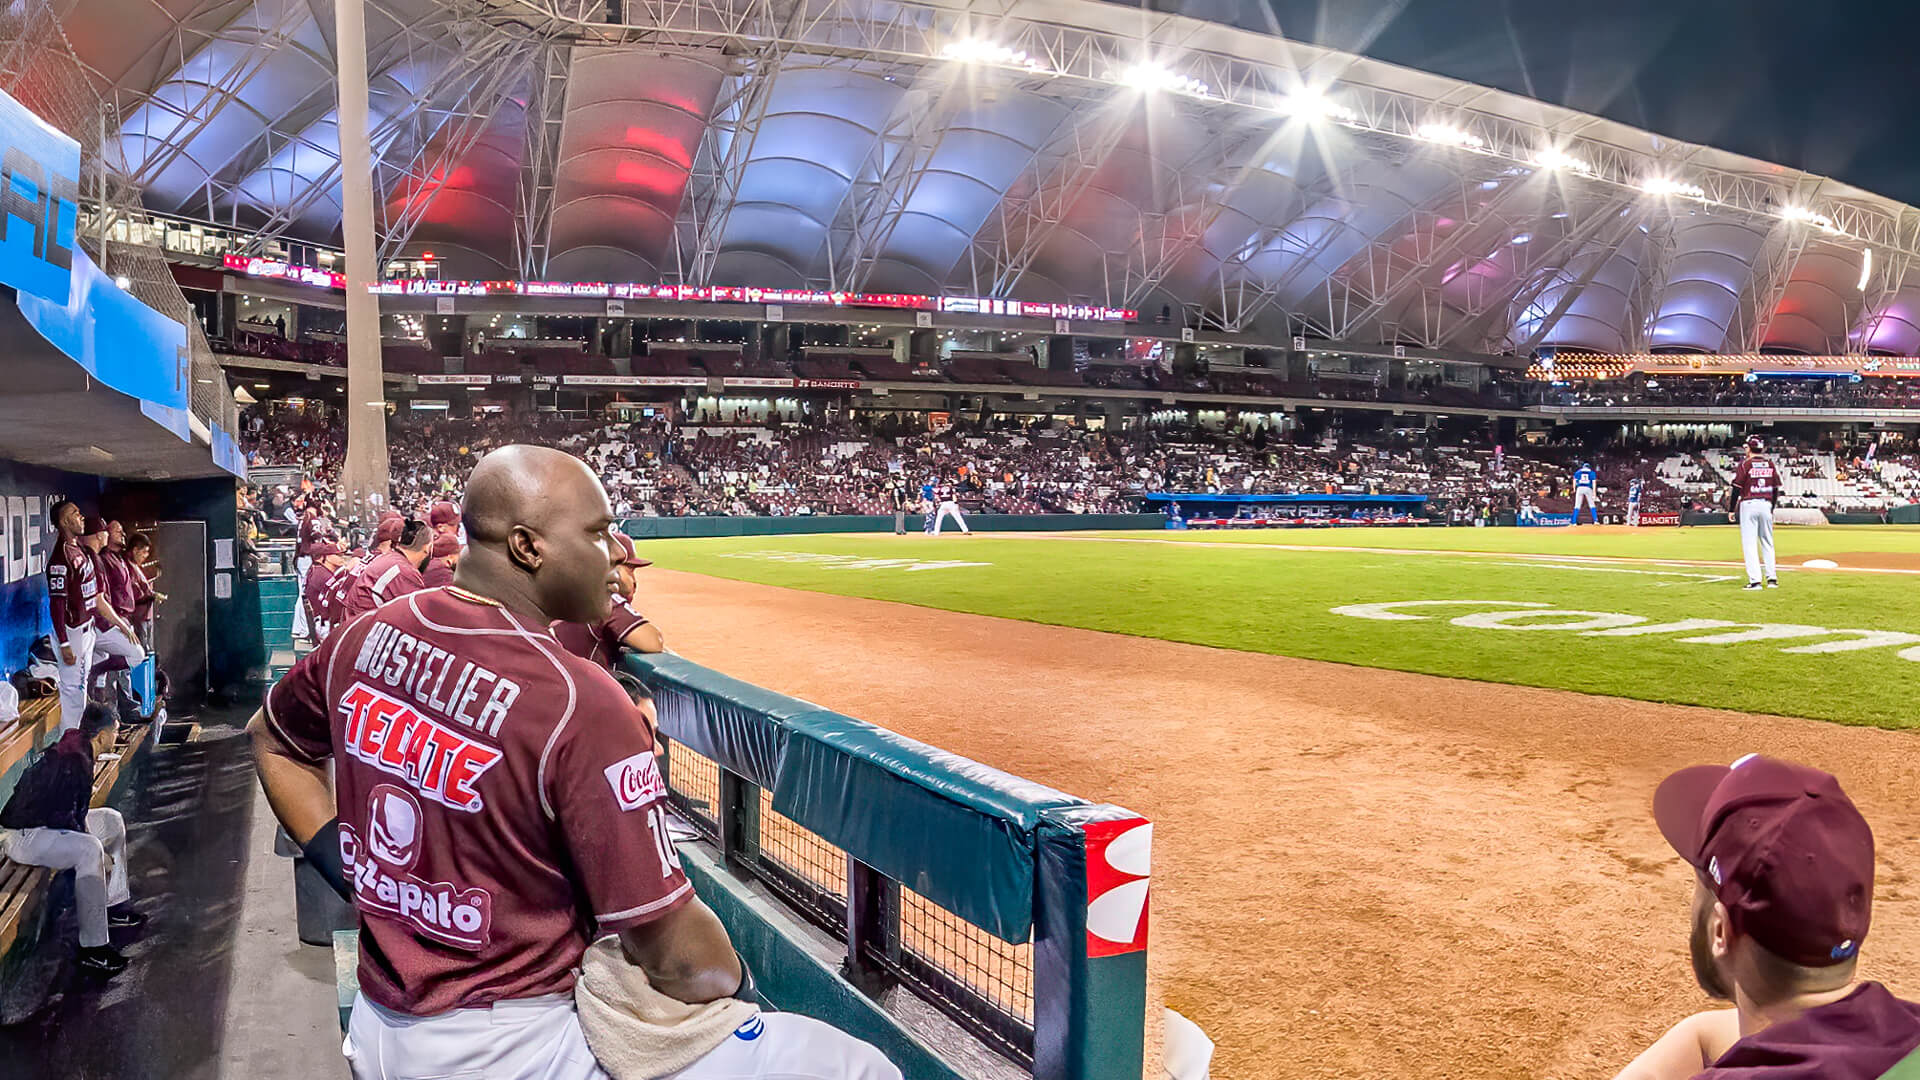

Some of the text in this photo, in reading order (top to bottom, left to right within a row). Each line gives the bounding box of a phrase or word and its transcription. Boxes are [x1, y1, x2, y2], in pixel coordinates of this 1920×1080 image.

[811, 381, 856, 389] BANORTE
[1641, 515, 1680, 525] BANORTE
[50, 577, 65, 590] 58
[340, 686, 504, 807] TECATE
